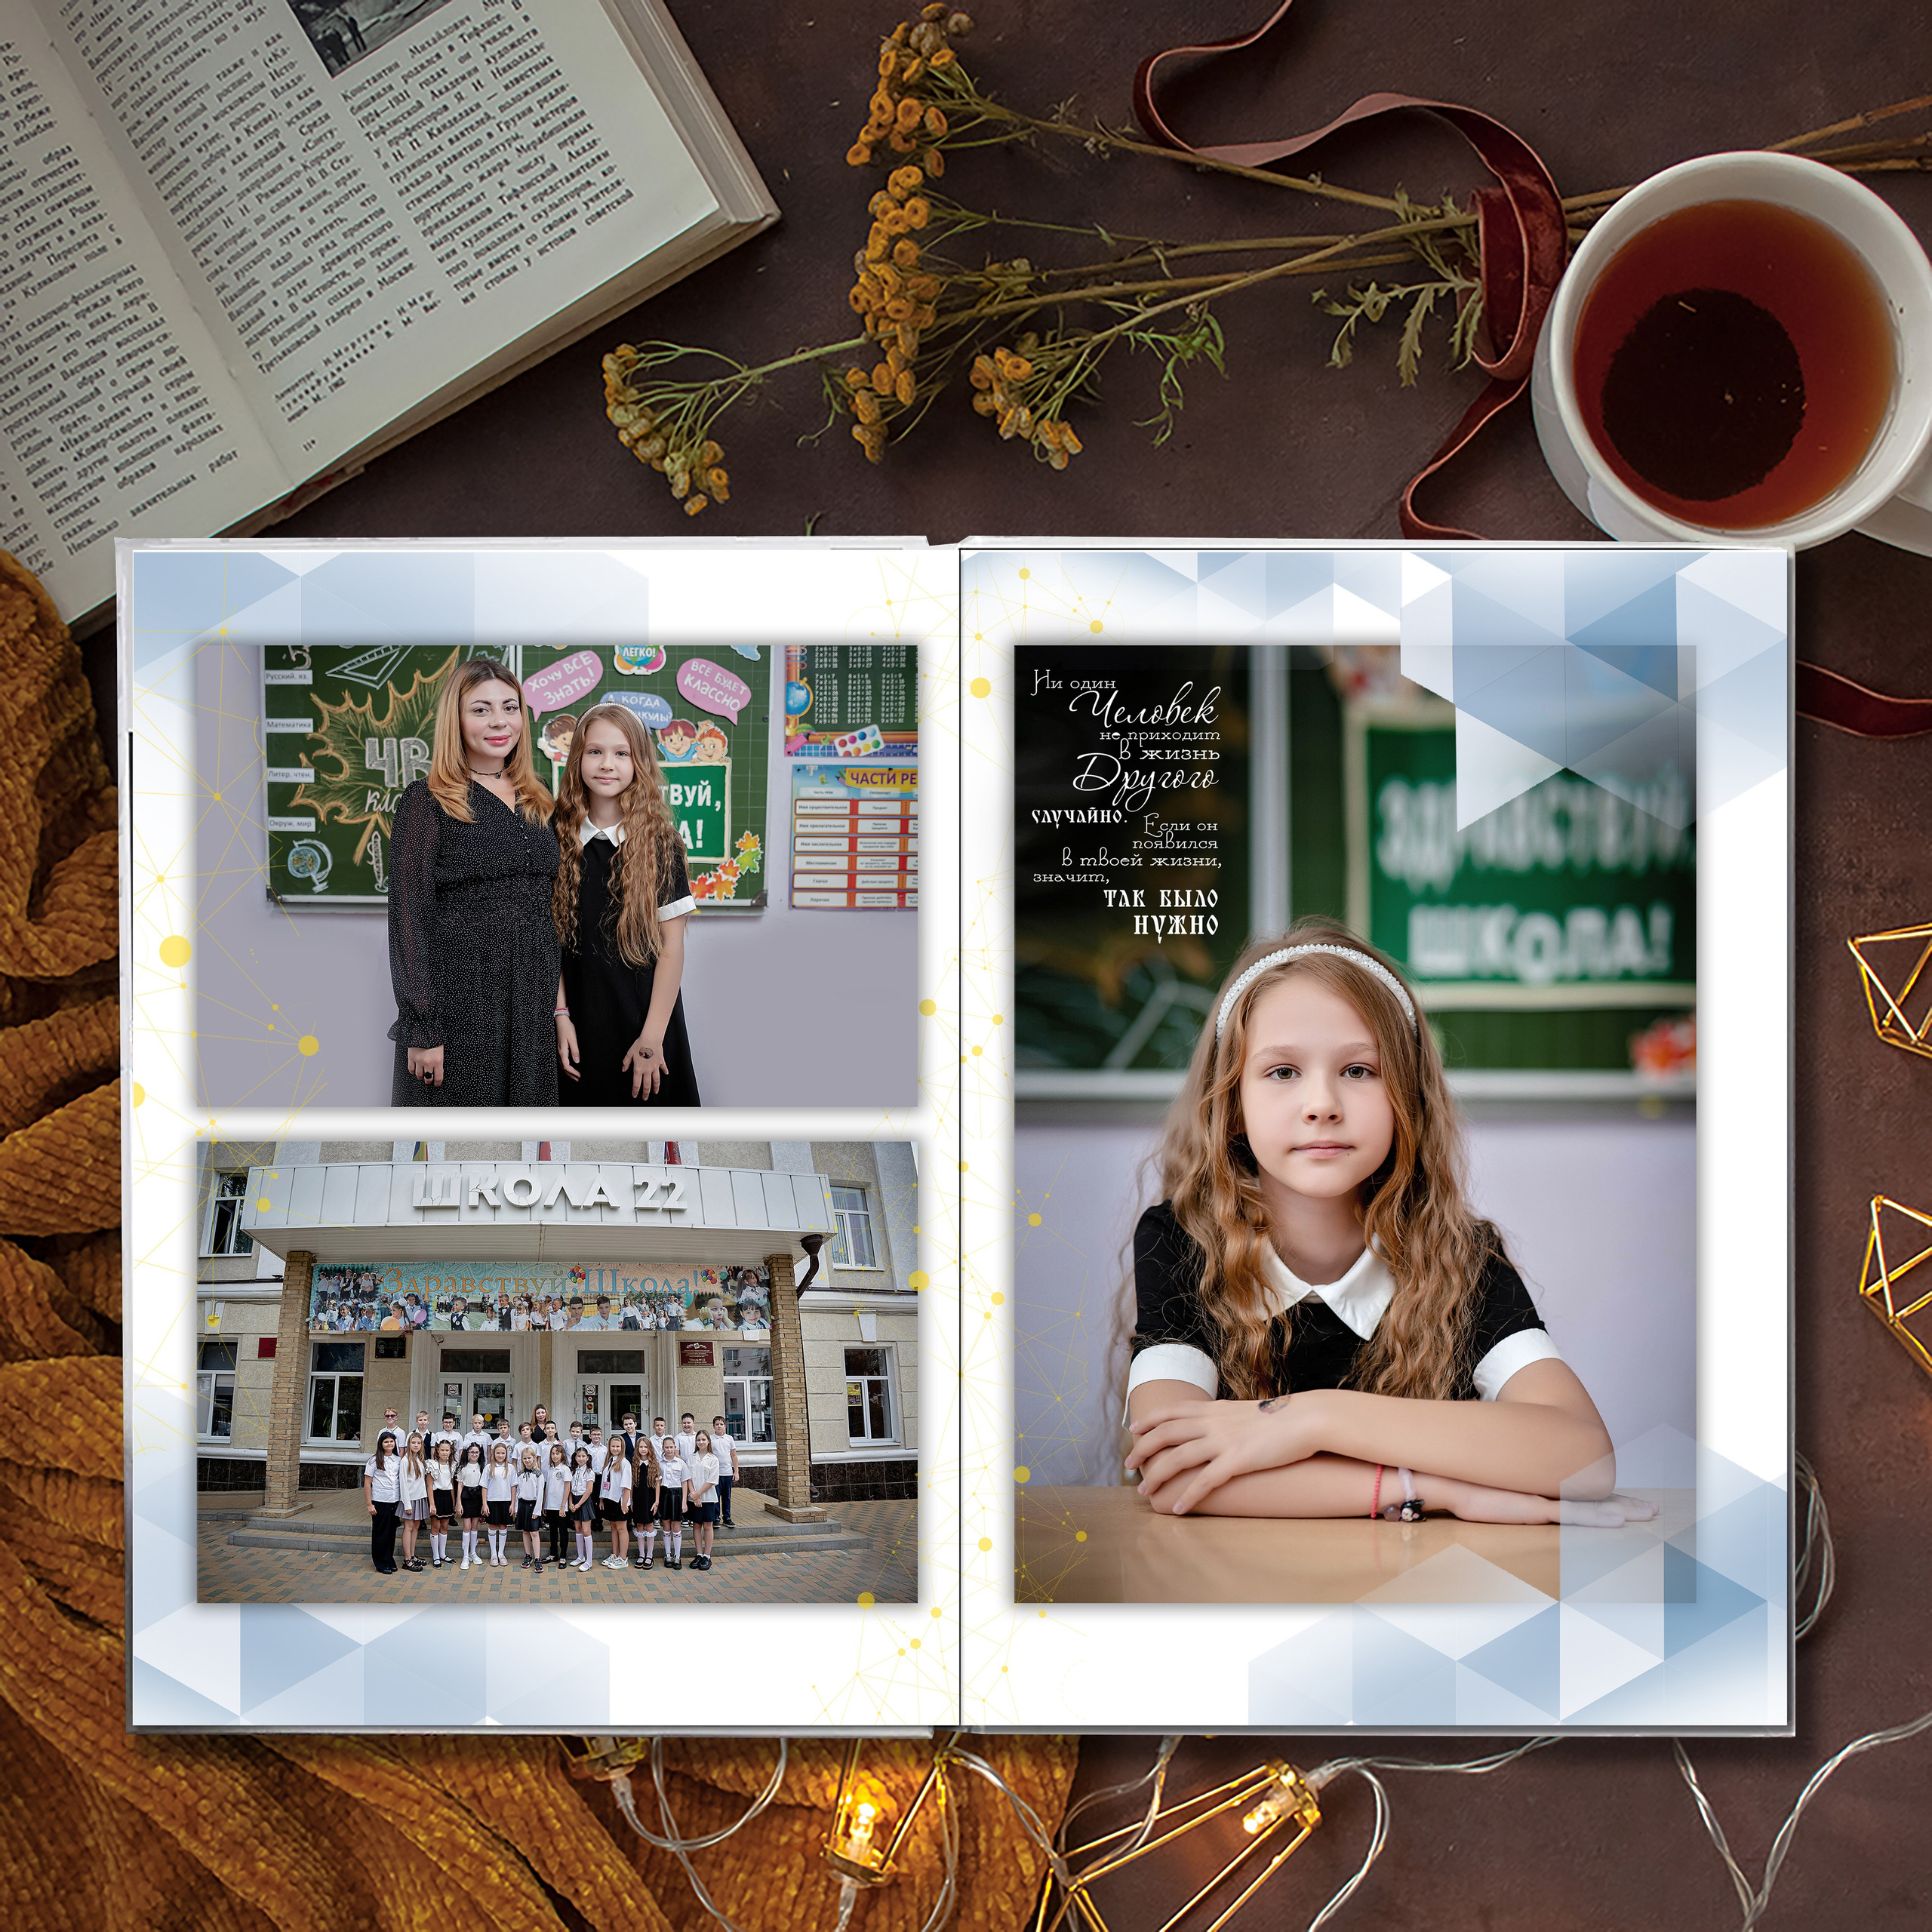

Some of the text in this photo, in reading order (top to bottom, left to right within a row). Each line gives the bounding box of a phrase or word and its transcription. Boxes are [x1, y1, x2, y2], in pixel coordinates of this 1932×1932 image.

[340, 14, 472, 103] Константин Михайлович
[623, 647, 656, 657] ЛЕГКО!
[528, 652, 593, 693] Хочу ВСЕ
[691, 661, 747, 695] ВСЁ БУДЕТ
[621, 696, 660, 708] КОГДА
[266, 721, 312, 729] Математика
[365, 737, 432, 788] 4В
[268, 771, 292, 779] Литер.
[851, 772, 897, 785] ЧАСТИ
[269, 820, 295, 829] Окруж.
[412, 1171, 688, 1211] ШКОЛА 22
[582, 1268, 700, 1296] Школа!
